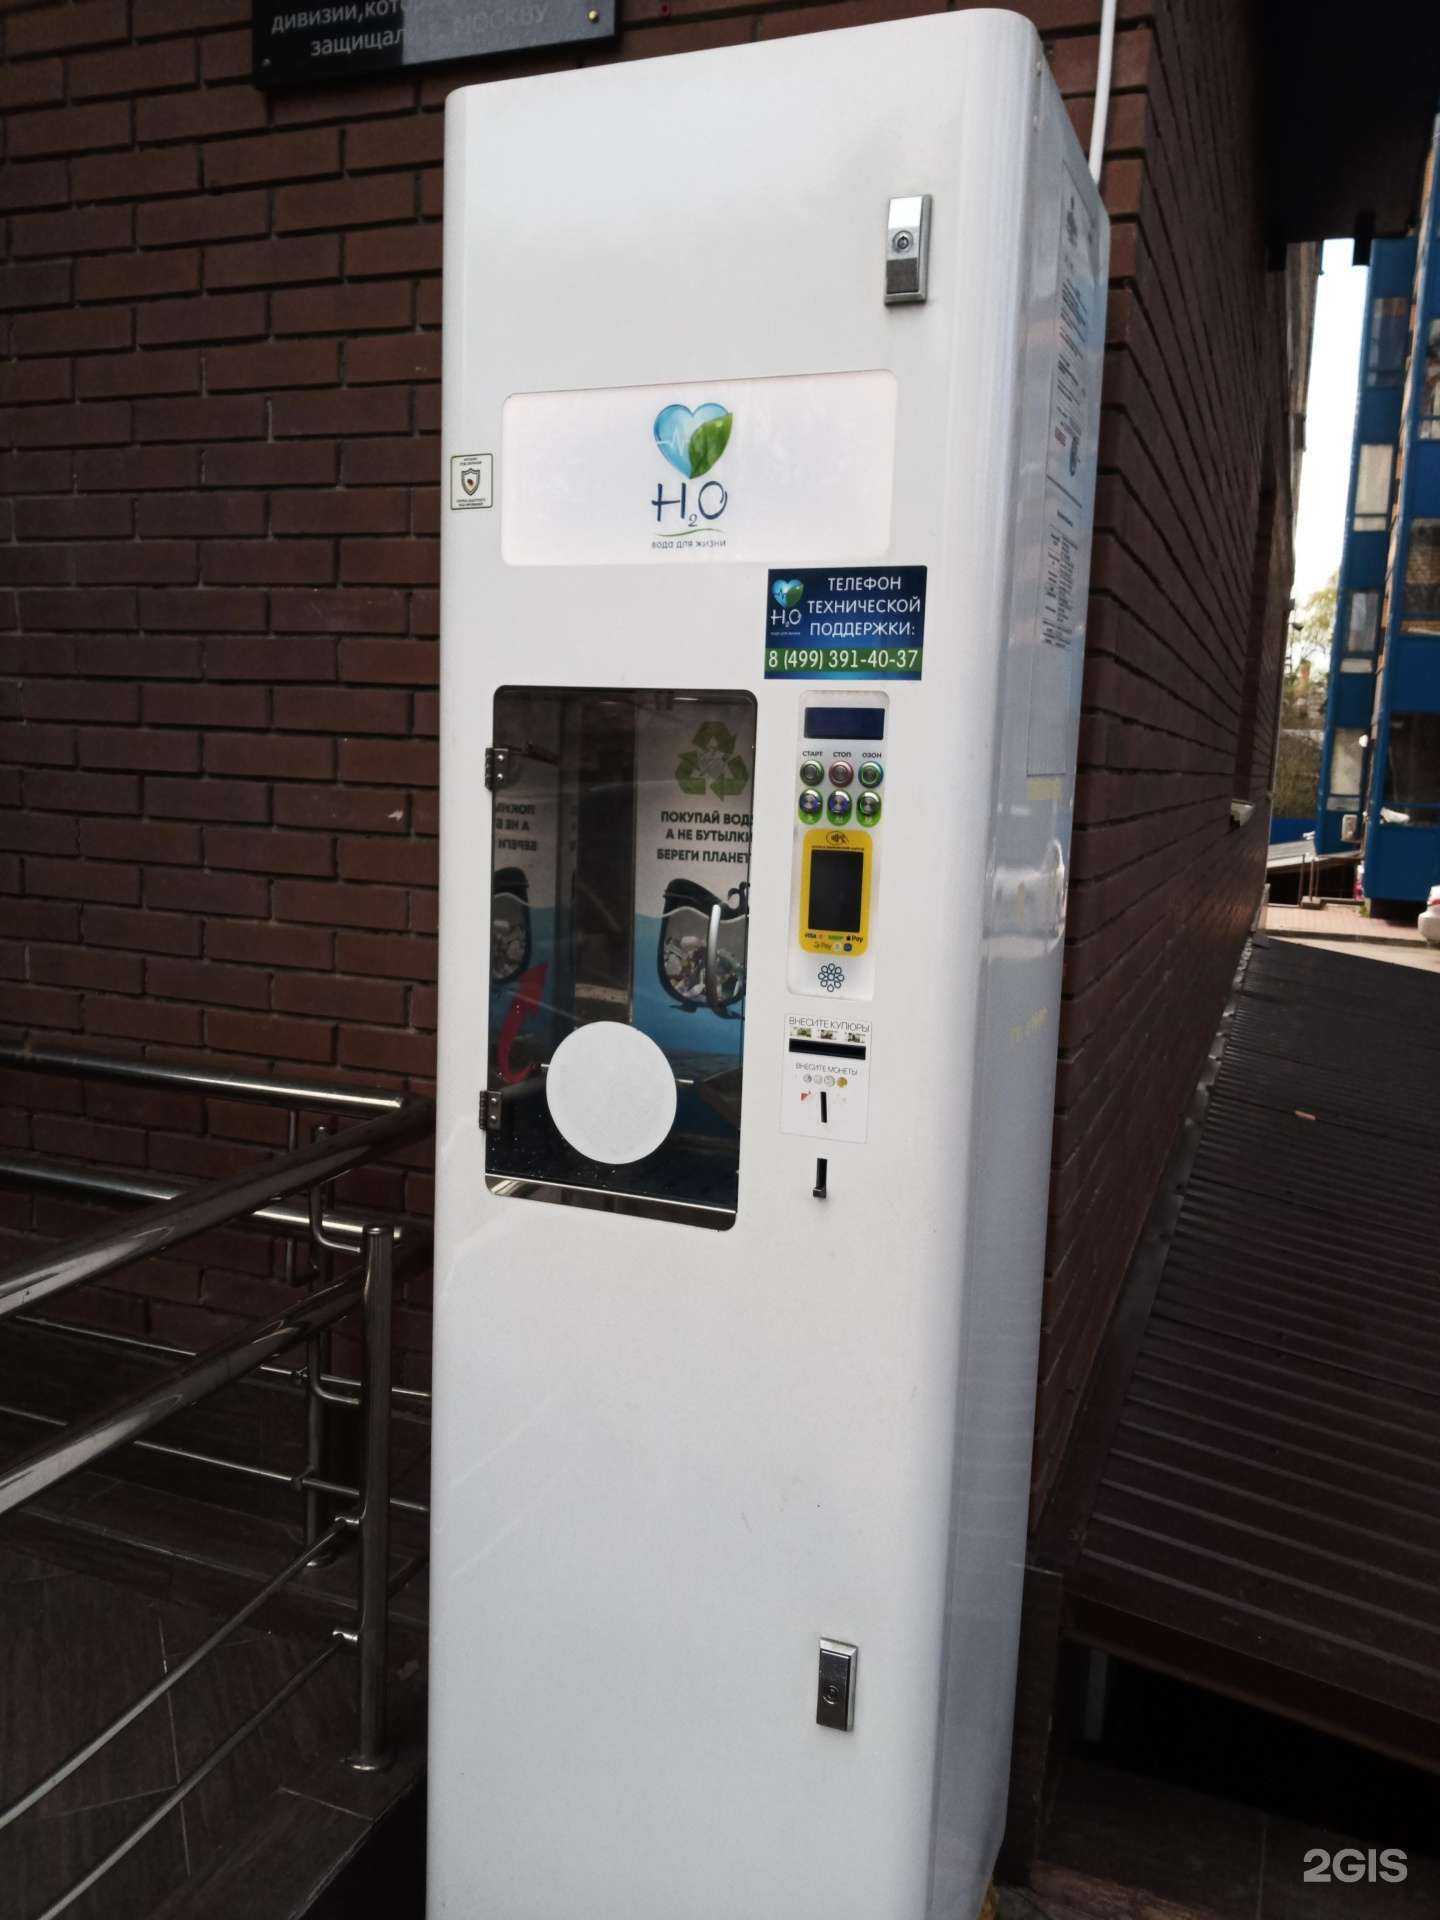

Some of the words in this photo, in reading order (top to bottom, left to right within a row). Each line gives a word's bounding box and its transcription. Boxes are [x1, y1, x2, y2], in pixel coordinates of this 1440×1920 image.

[828, 576, 901, 591] ТЕЛЕФОН
[808, 595, 921, 614] ТЕХНИЧЕСКОЙ
[810, 621, 916, 638] ПОДДЕРЖКИ:
[768, 650, 778, 668] 8
[784, 650, 823, 670] (499)
[828, 649, 918, 668] 391-40-37
[660, 810, 720, 824] ПОКУПАЙ
[665, 829, 674, 839] А
[677, 829, 693, 840] НЕ
[656, 848, 699, 861] БЕРЕГИ
[702, 850, 751, 864] ПЛАНЕТ
[788, 1016, 829, 1029] ВНЕСИТЕ
